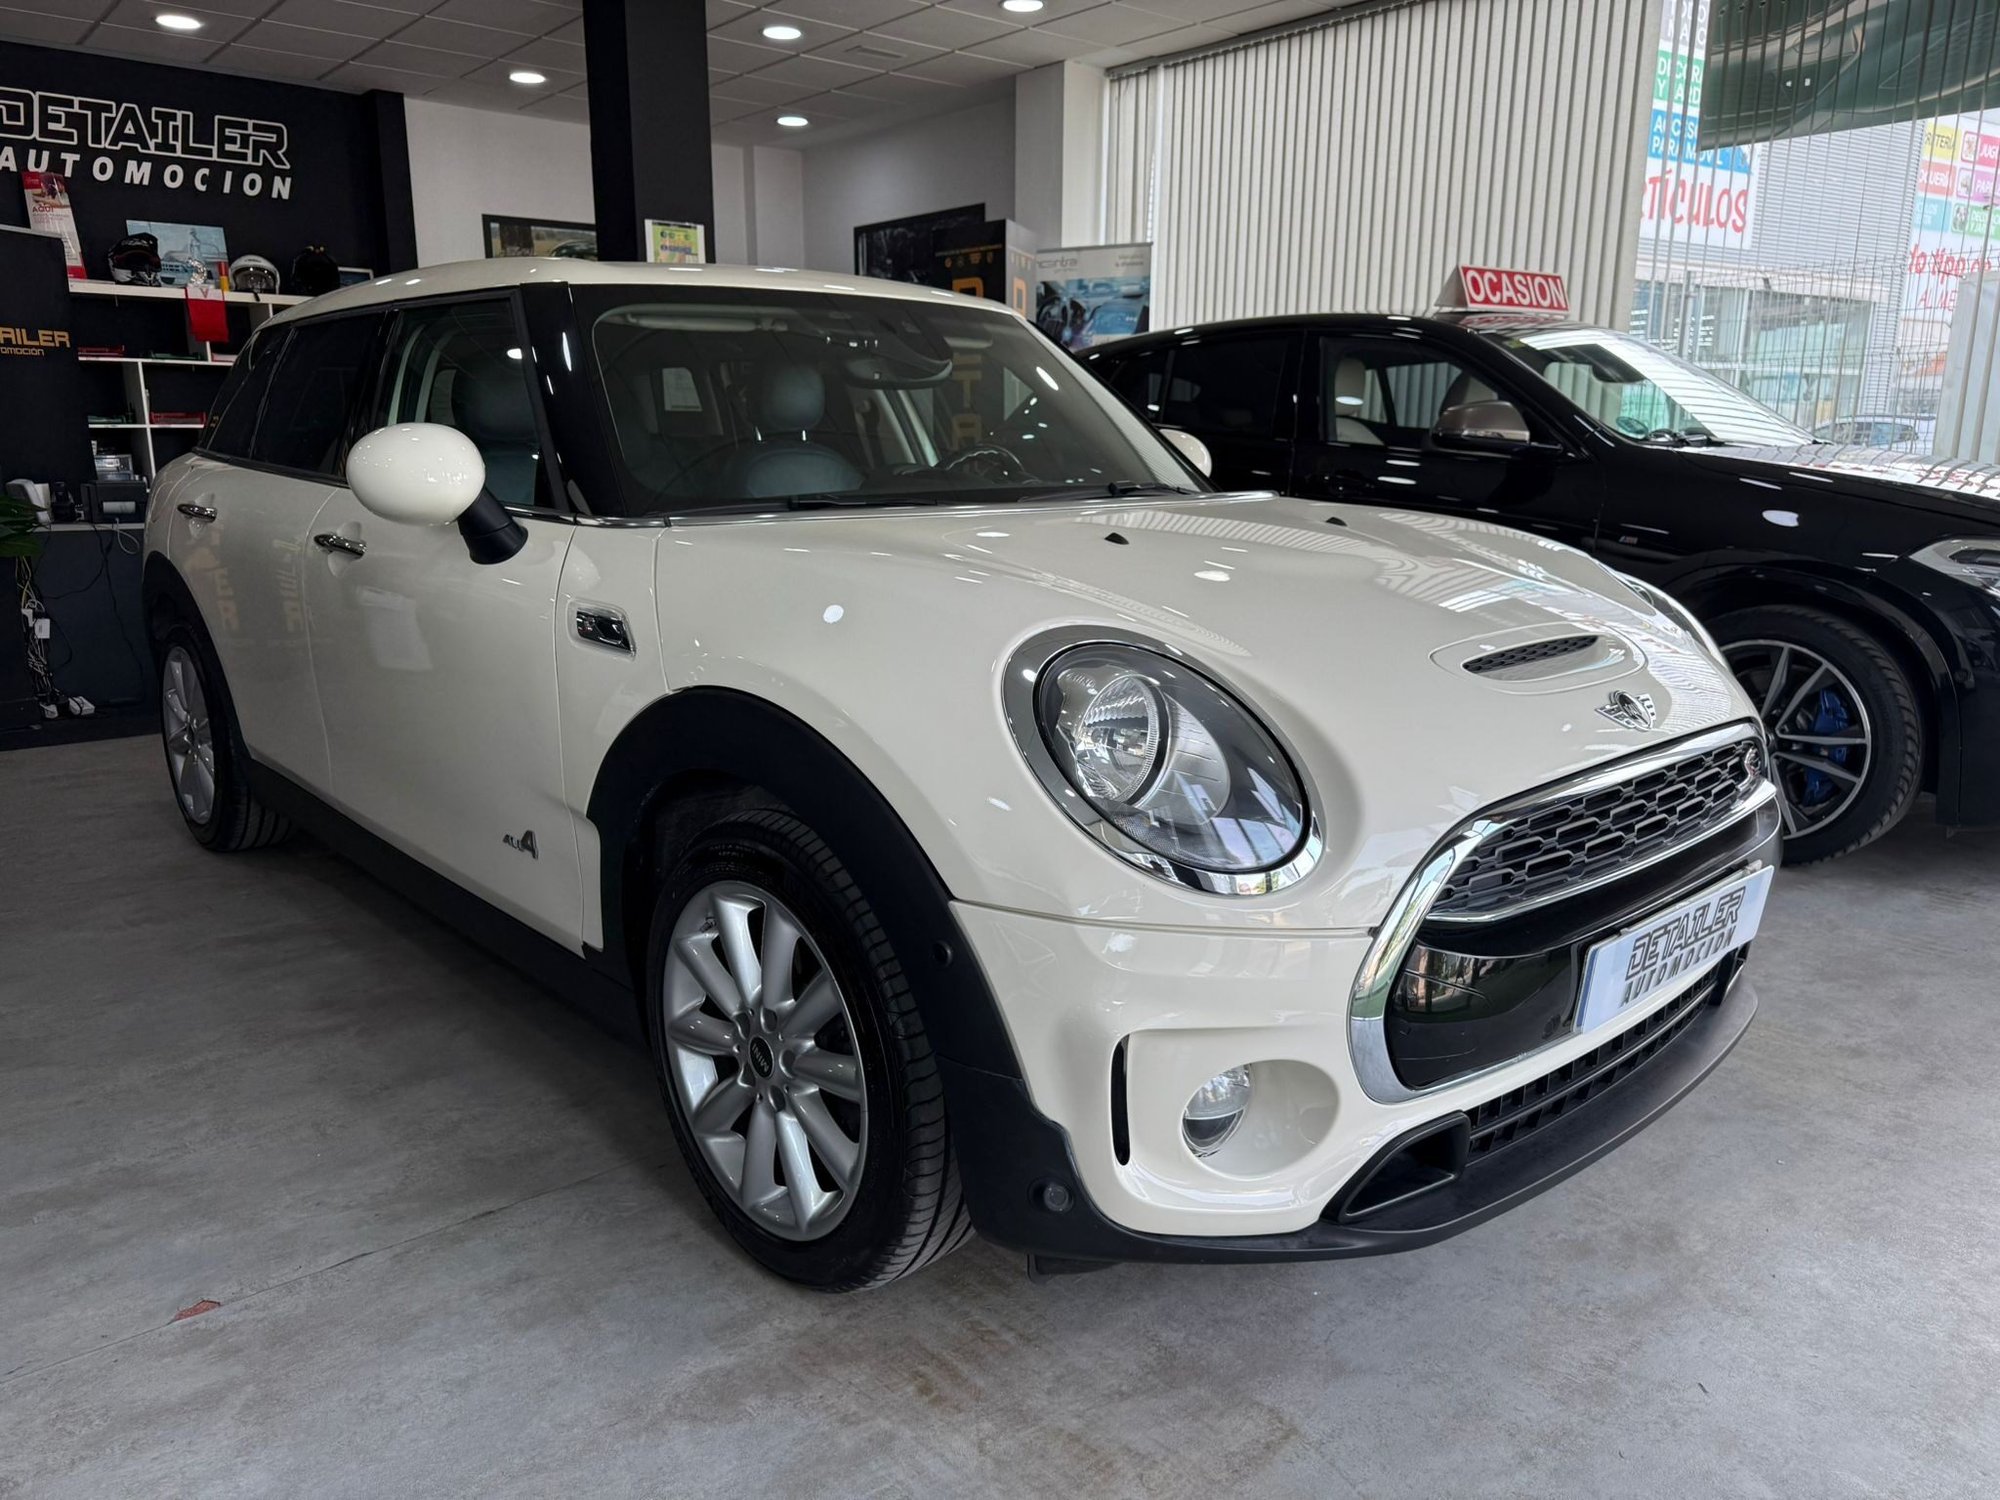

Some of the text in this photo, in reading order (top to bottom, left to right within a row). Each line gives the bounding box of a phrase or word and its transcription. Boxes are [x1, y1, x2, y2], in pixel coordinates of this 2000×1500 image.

[0, 86, 291, 170] DETAILER
[0, 146, 292, 200] AUTOMOCION
[1465, 269, 1567, 309] OCASION
[1620, 925, 1736, 1008] AUTOMOCION
[1625, 886, 1746, 981] DETAILER
